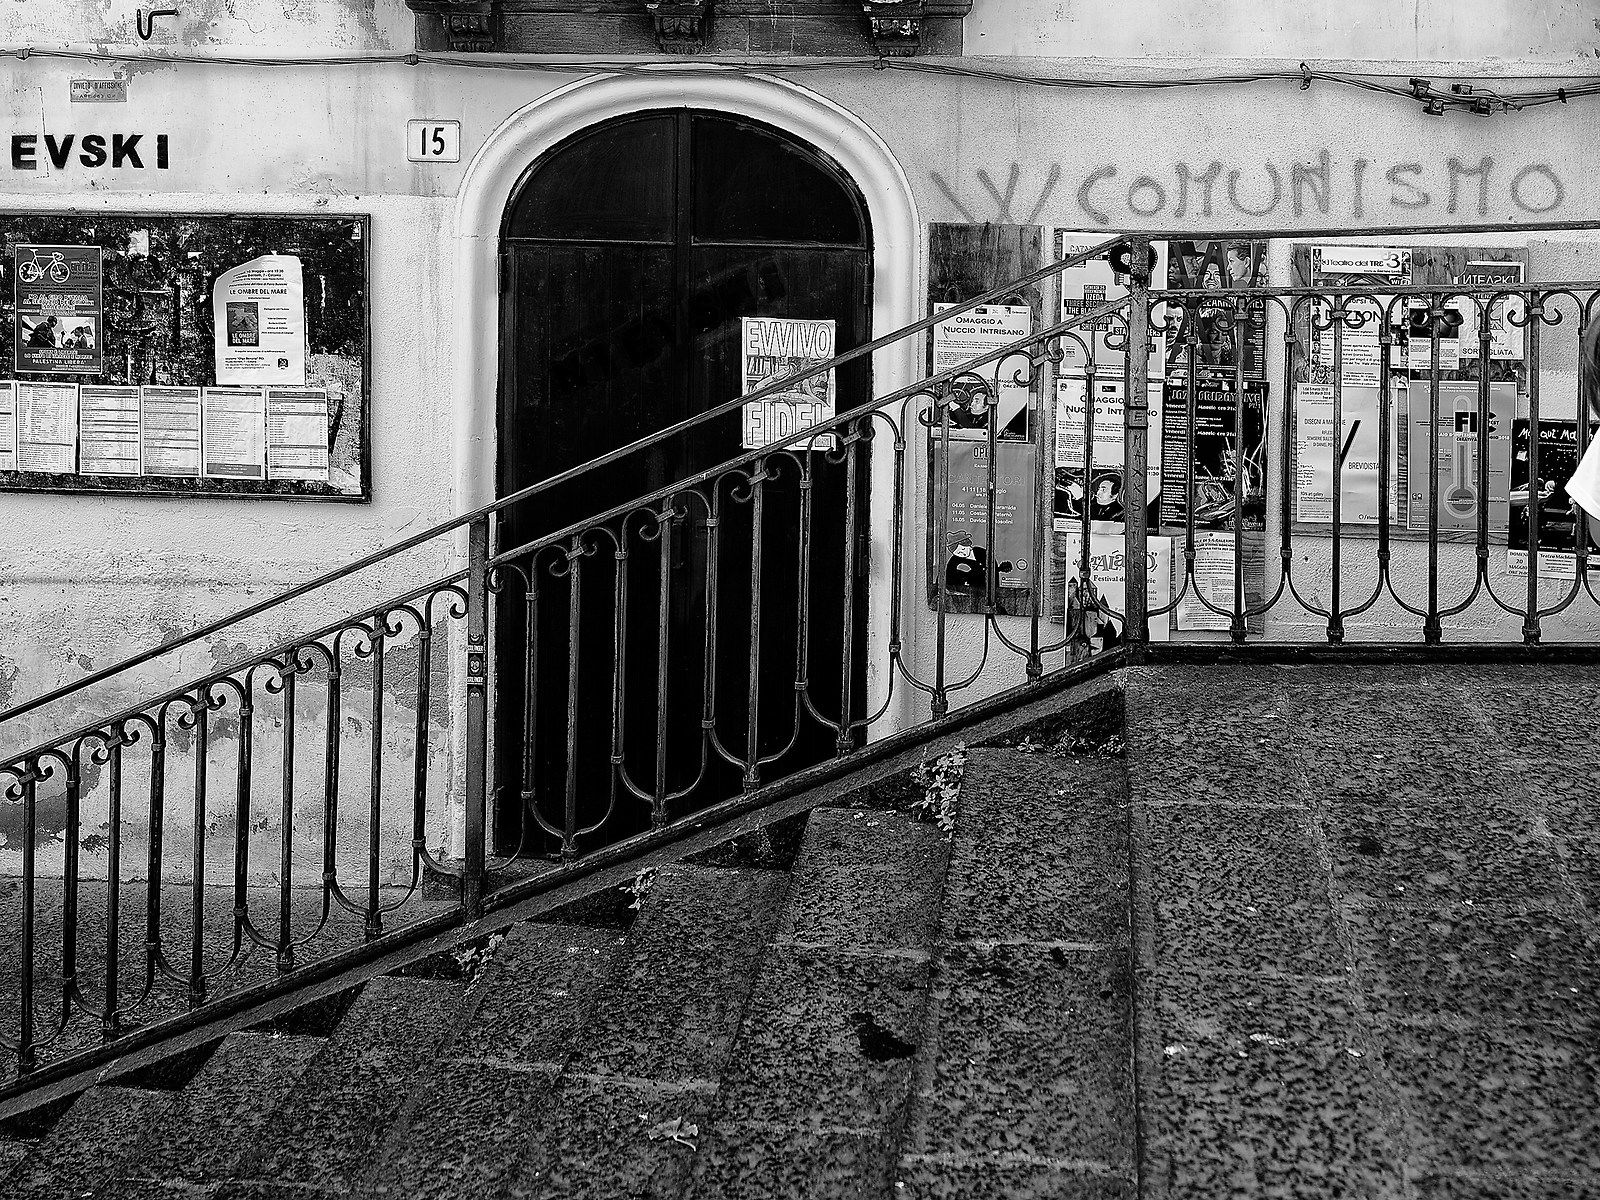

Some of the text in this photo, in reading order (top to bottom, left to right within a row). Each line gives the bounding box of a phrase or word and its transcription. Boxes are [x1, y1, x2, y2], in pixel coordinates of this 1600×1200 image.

[11, 133, 169, 170] EVSKI
[421, 127, 446, 156] 15
[1076, 147, 1566, 224] COMUNISMO
[943, 326, 1025, 336] NUCCIO INTRISANO
[955, 316, 1004, 326] OMAGGIO A
[745, 320, 832, 358] EVVIVO
[1092, 574, 1119, 583] Festival
